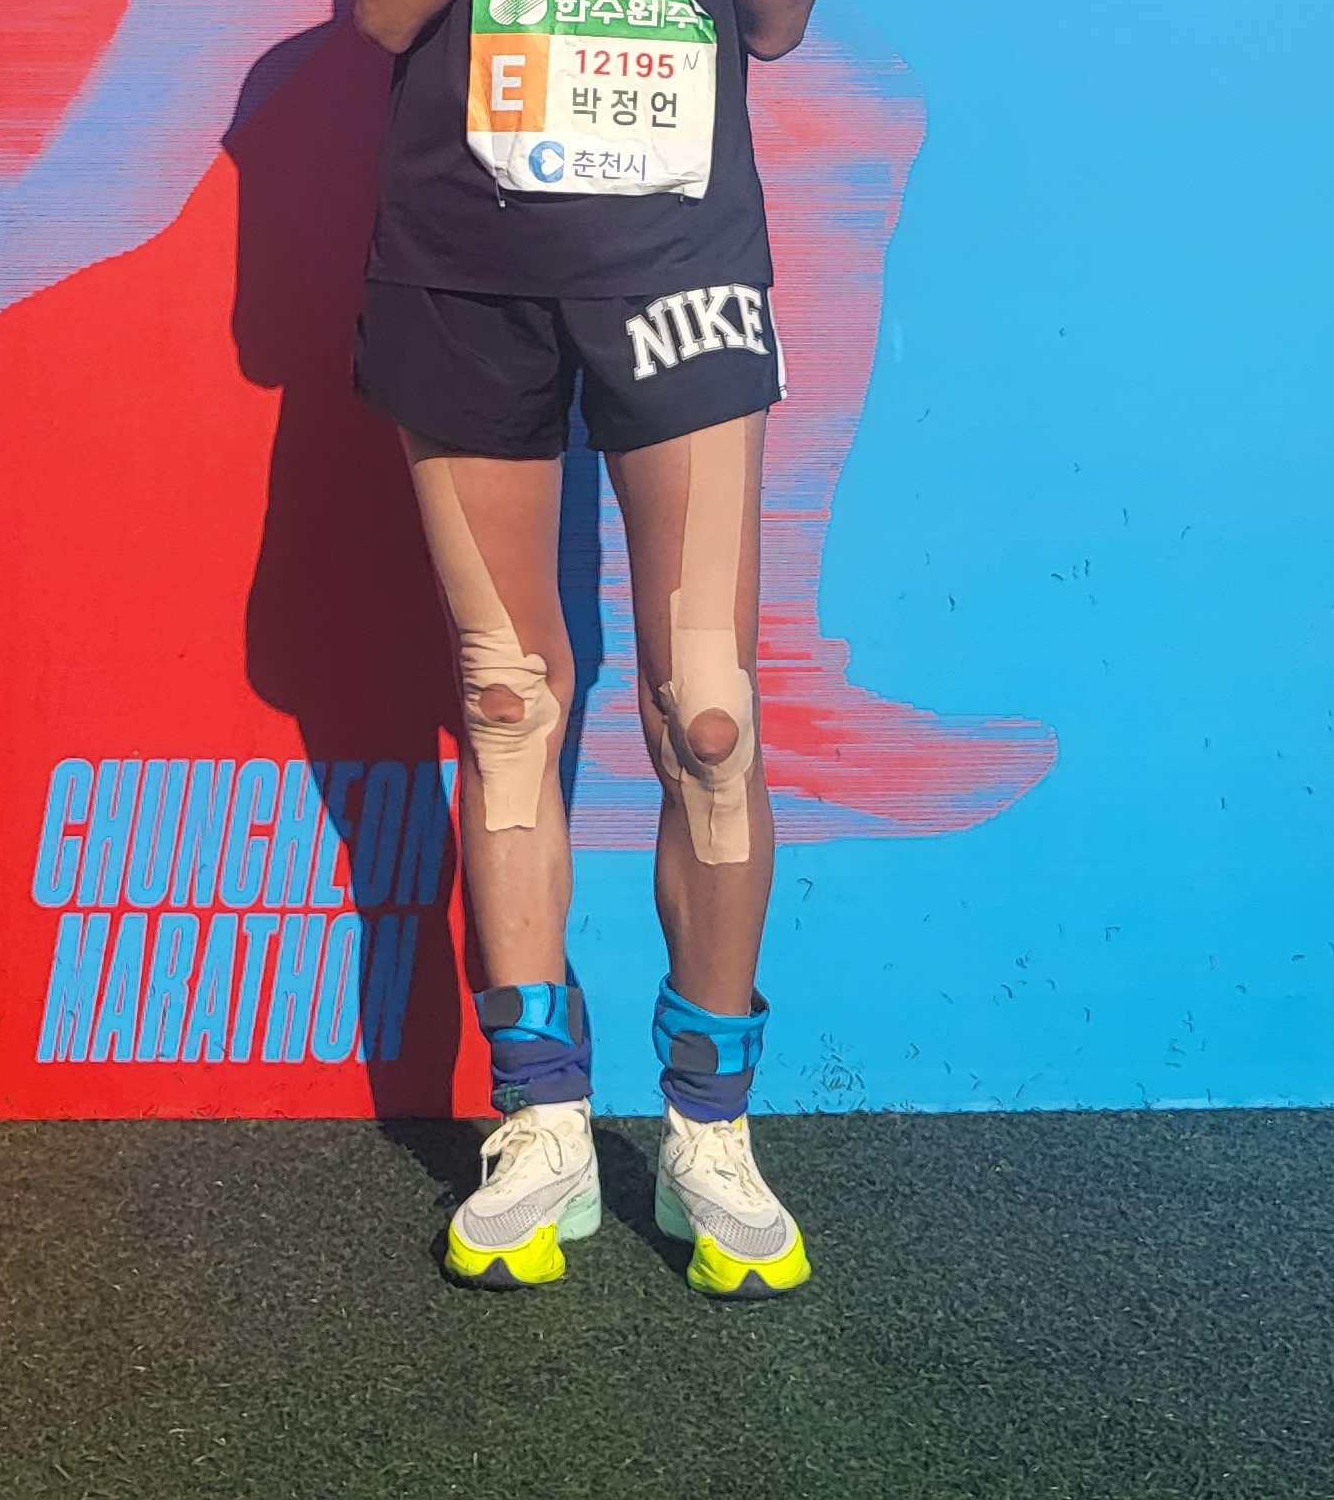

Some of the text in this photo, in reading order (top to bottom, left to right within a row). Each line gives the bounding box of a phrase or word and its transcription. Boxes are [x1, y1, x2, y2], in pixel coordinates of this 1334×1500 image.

[490, 53, 526, 112] E
[574, 49, 675, 79] 12195
[571, 86, 678, 128] 박정언
[572, 150, 647, 182] 춘천시
[624, 283, 770, 381] NIKE
[32, 758, 459, 908] CHUNCHEON
[36, 912, 419, 1064] MARATHON
